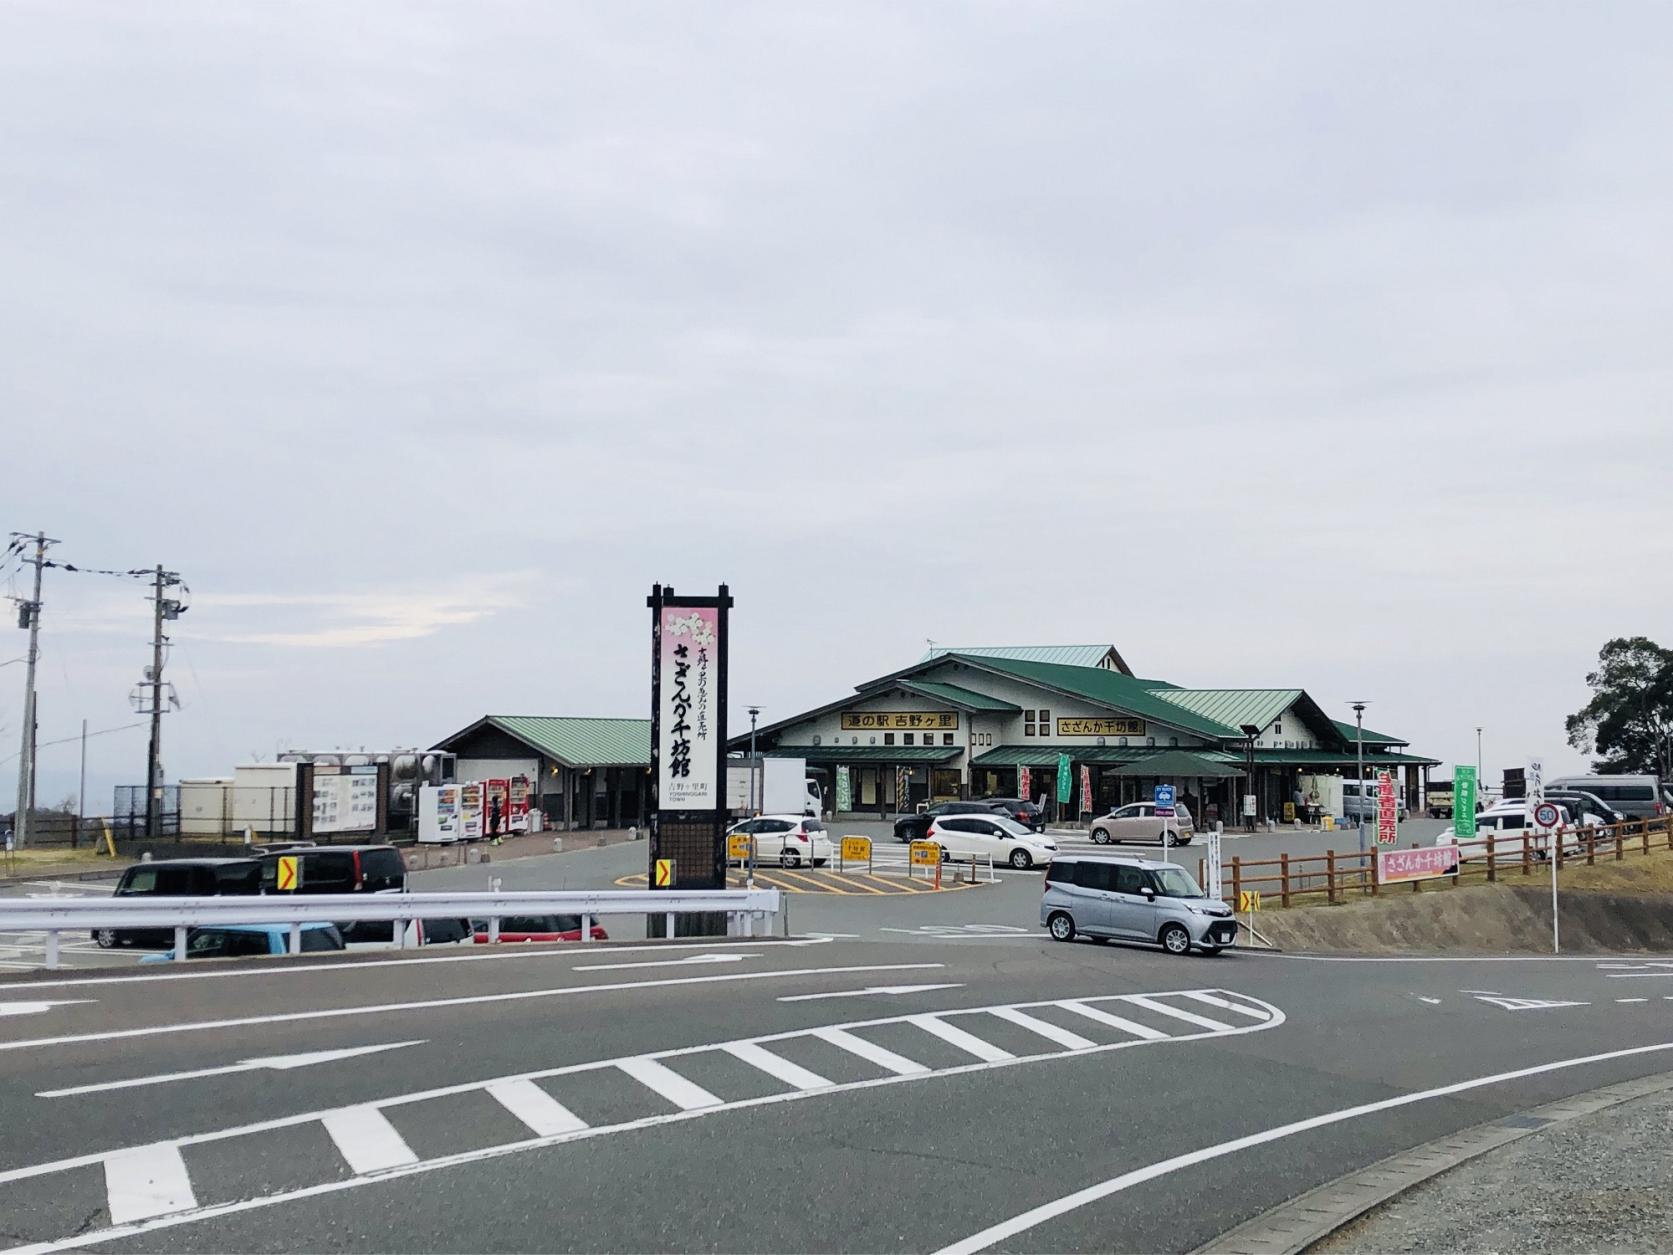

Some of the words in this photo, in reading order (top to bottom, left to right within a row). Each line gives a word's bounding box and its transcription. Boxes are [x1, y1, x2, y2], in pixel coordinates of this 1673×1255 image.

[668, 643, 692, 778] さざんか千坊館
[848, 714, 889, 727] 道の駅
[895, 714, 952, 727] 吉野ヶ里
[1378, 771, 1397, 844] 生産者直売所
[1540, 810, 1554, 821] 50
[1387, 850, 1452, 873] さざんか千坊館
